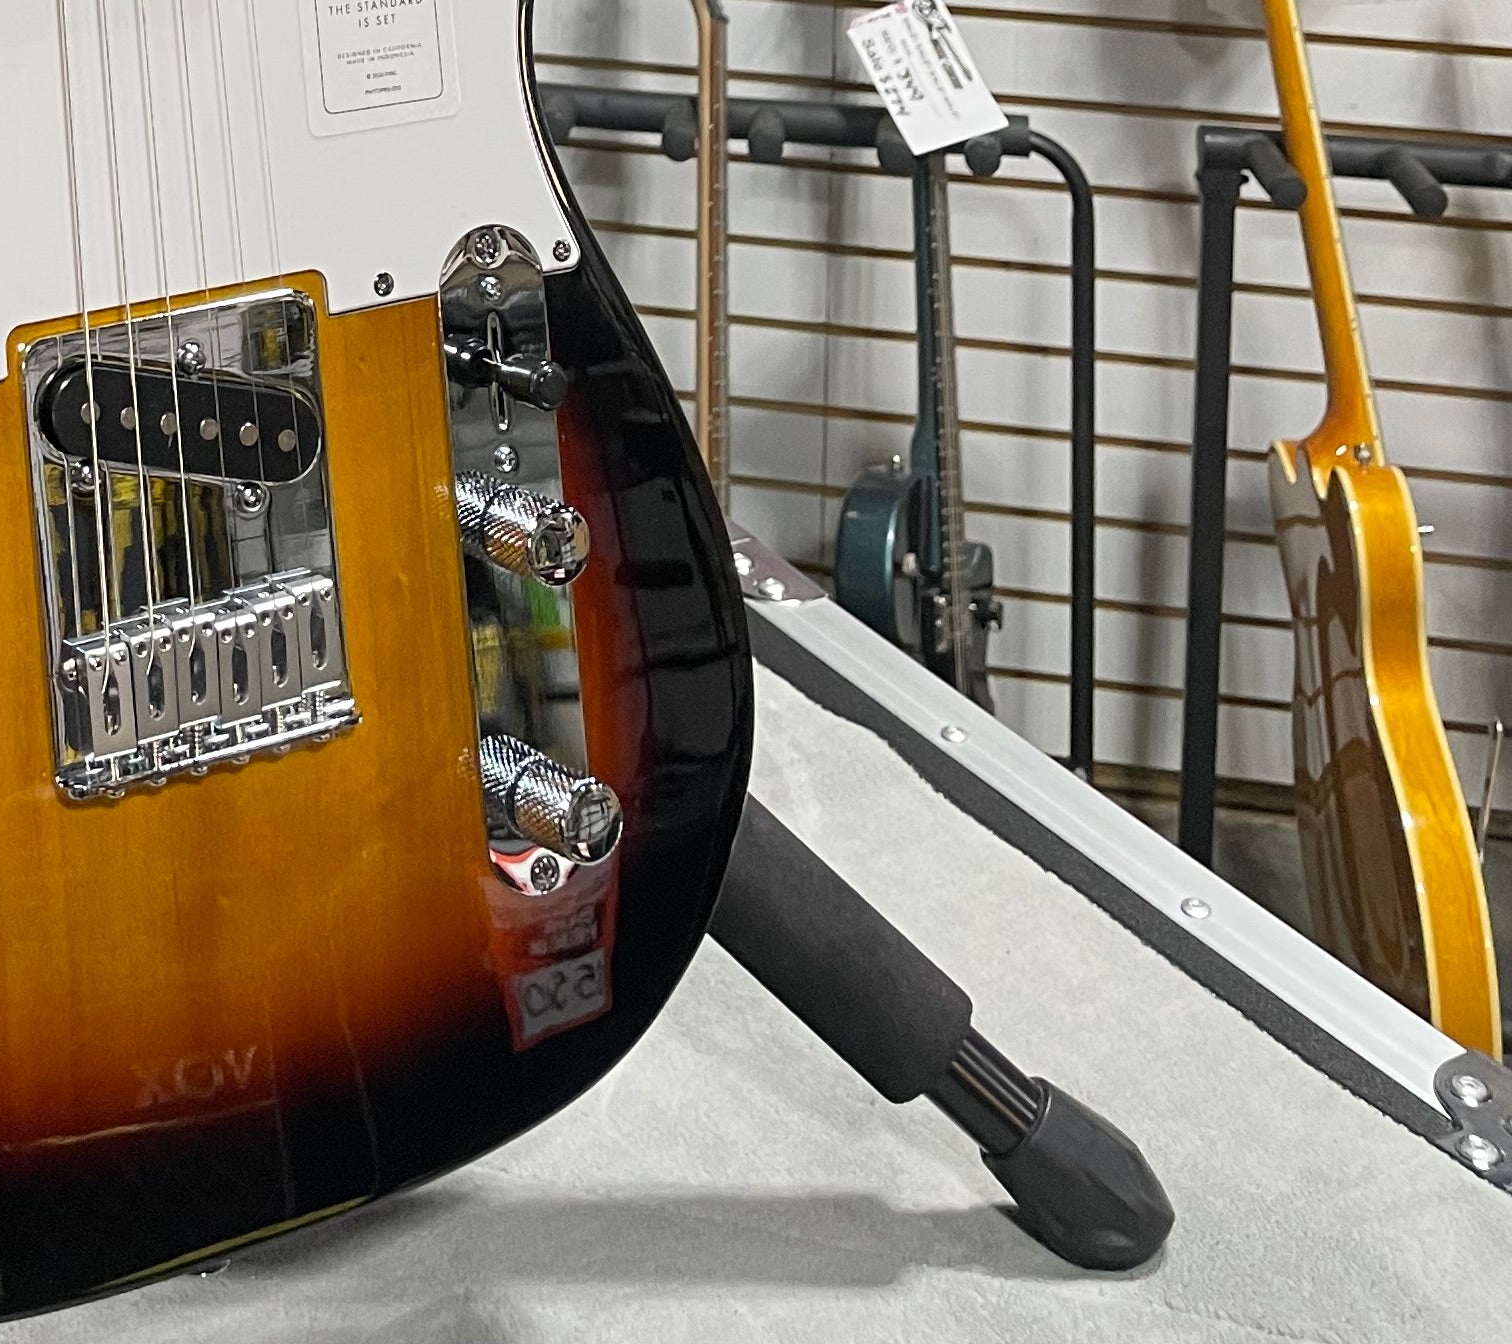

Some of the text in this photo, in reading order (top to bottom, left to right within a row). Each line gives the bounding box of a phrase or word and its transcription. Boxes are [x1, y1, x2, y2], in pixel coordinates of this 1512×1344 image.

[328, 3, 351, 17] THE
[358, 13, 397, 28] IS SET
